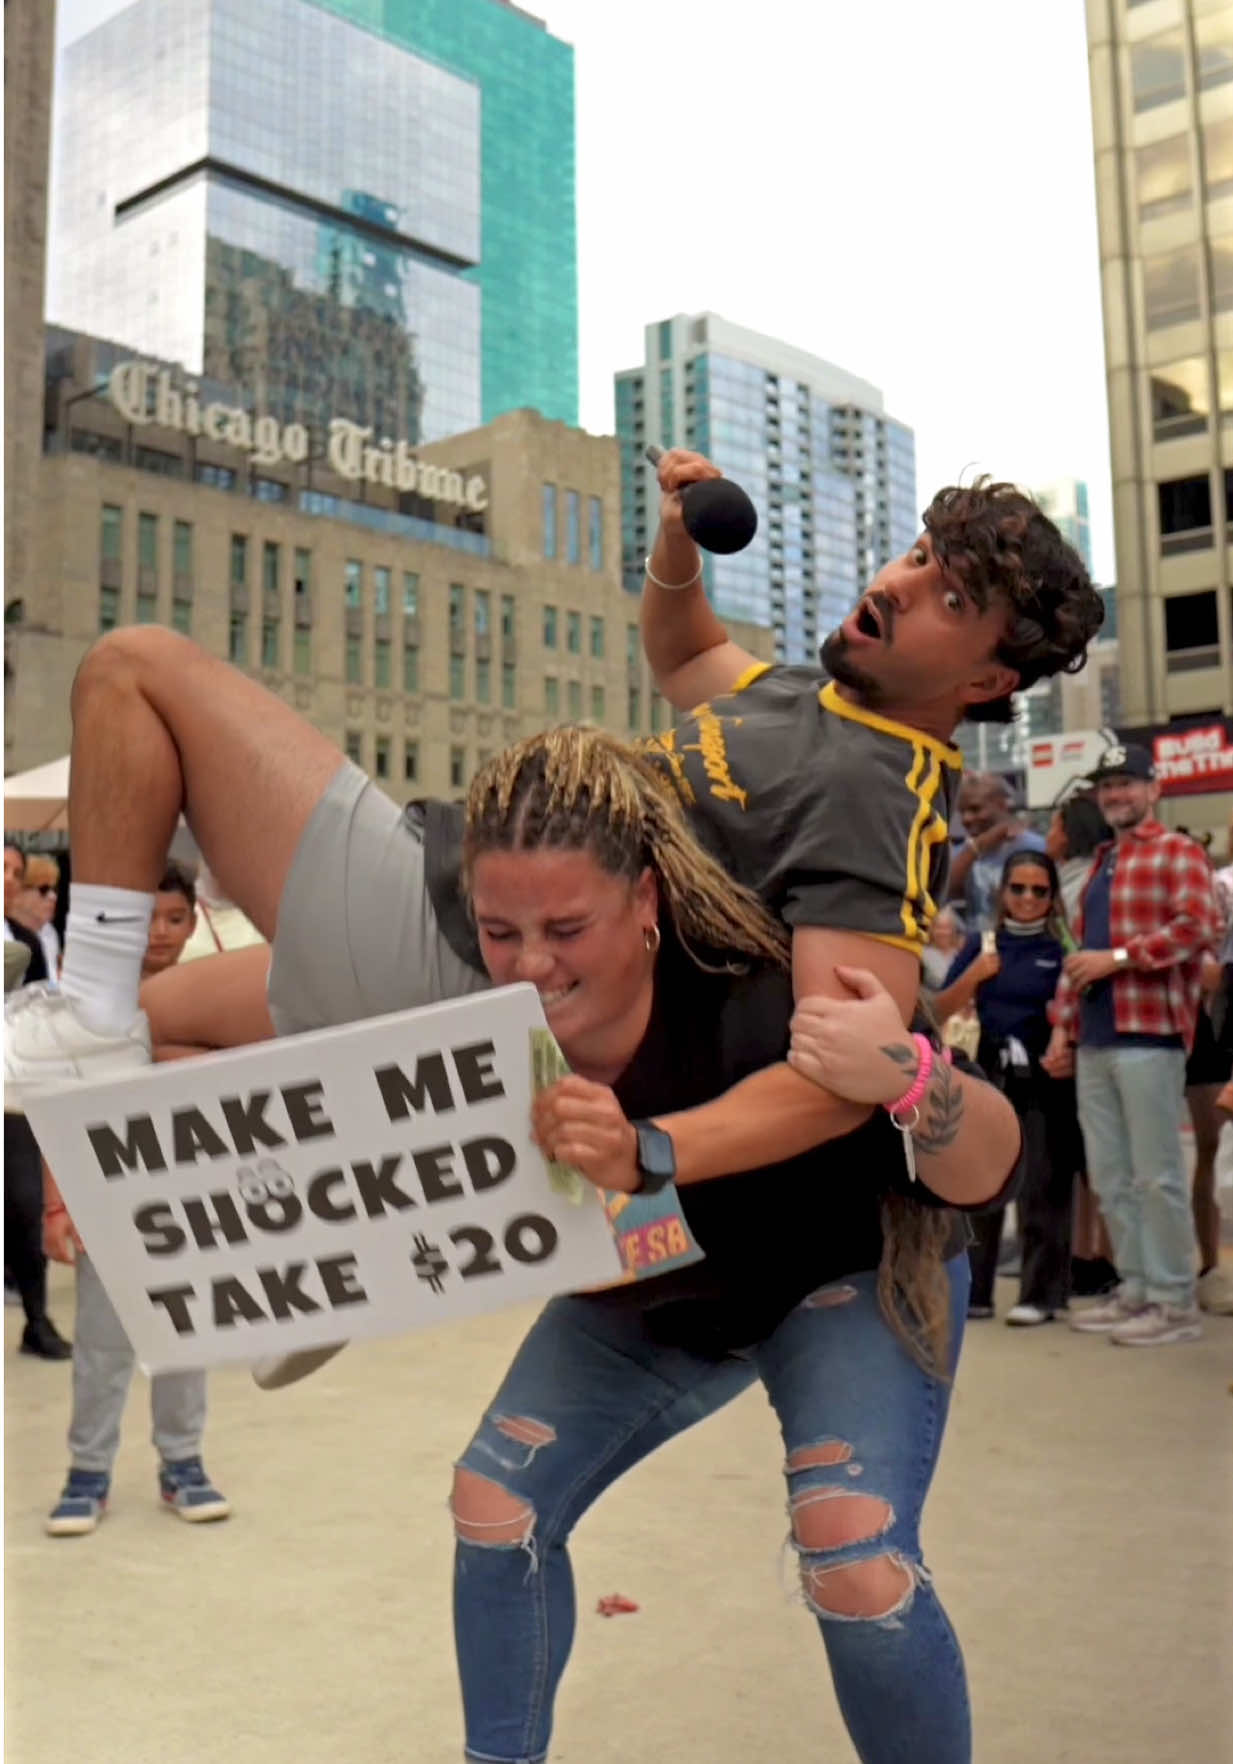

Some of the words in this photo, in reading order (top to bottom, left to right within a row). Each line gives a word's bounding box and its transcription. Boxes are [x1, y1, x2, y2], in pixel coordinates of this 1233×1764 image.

[110, 361, 309, 463] Chicago
[328, 417, 488, 511] Tribune
[86, 1079, 335, 1179] MAKE
[374, 1039, 506, 1123] ME
[133, 1135, 517, 1257] SHOCKED
[146, 1253, 368, 1335] TAKE
[411, 1212, 559, 1293] $20
